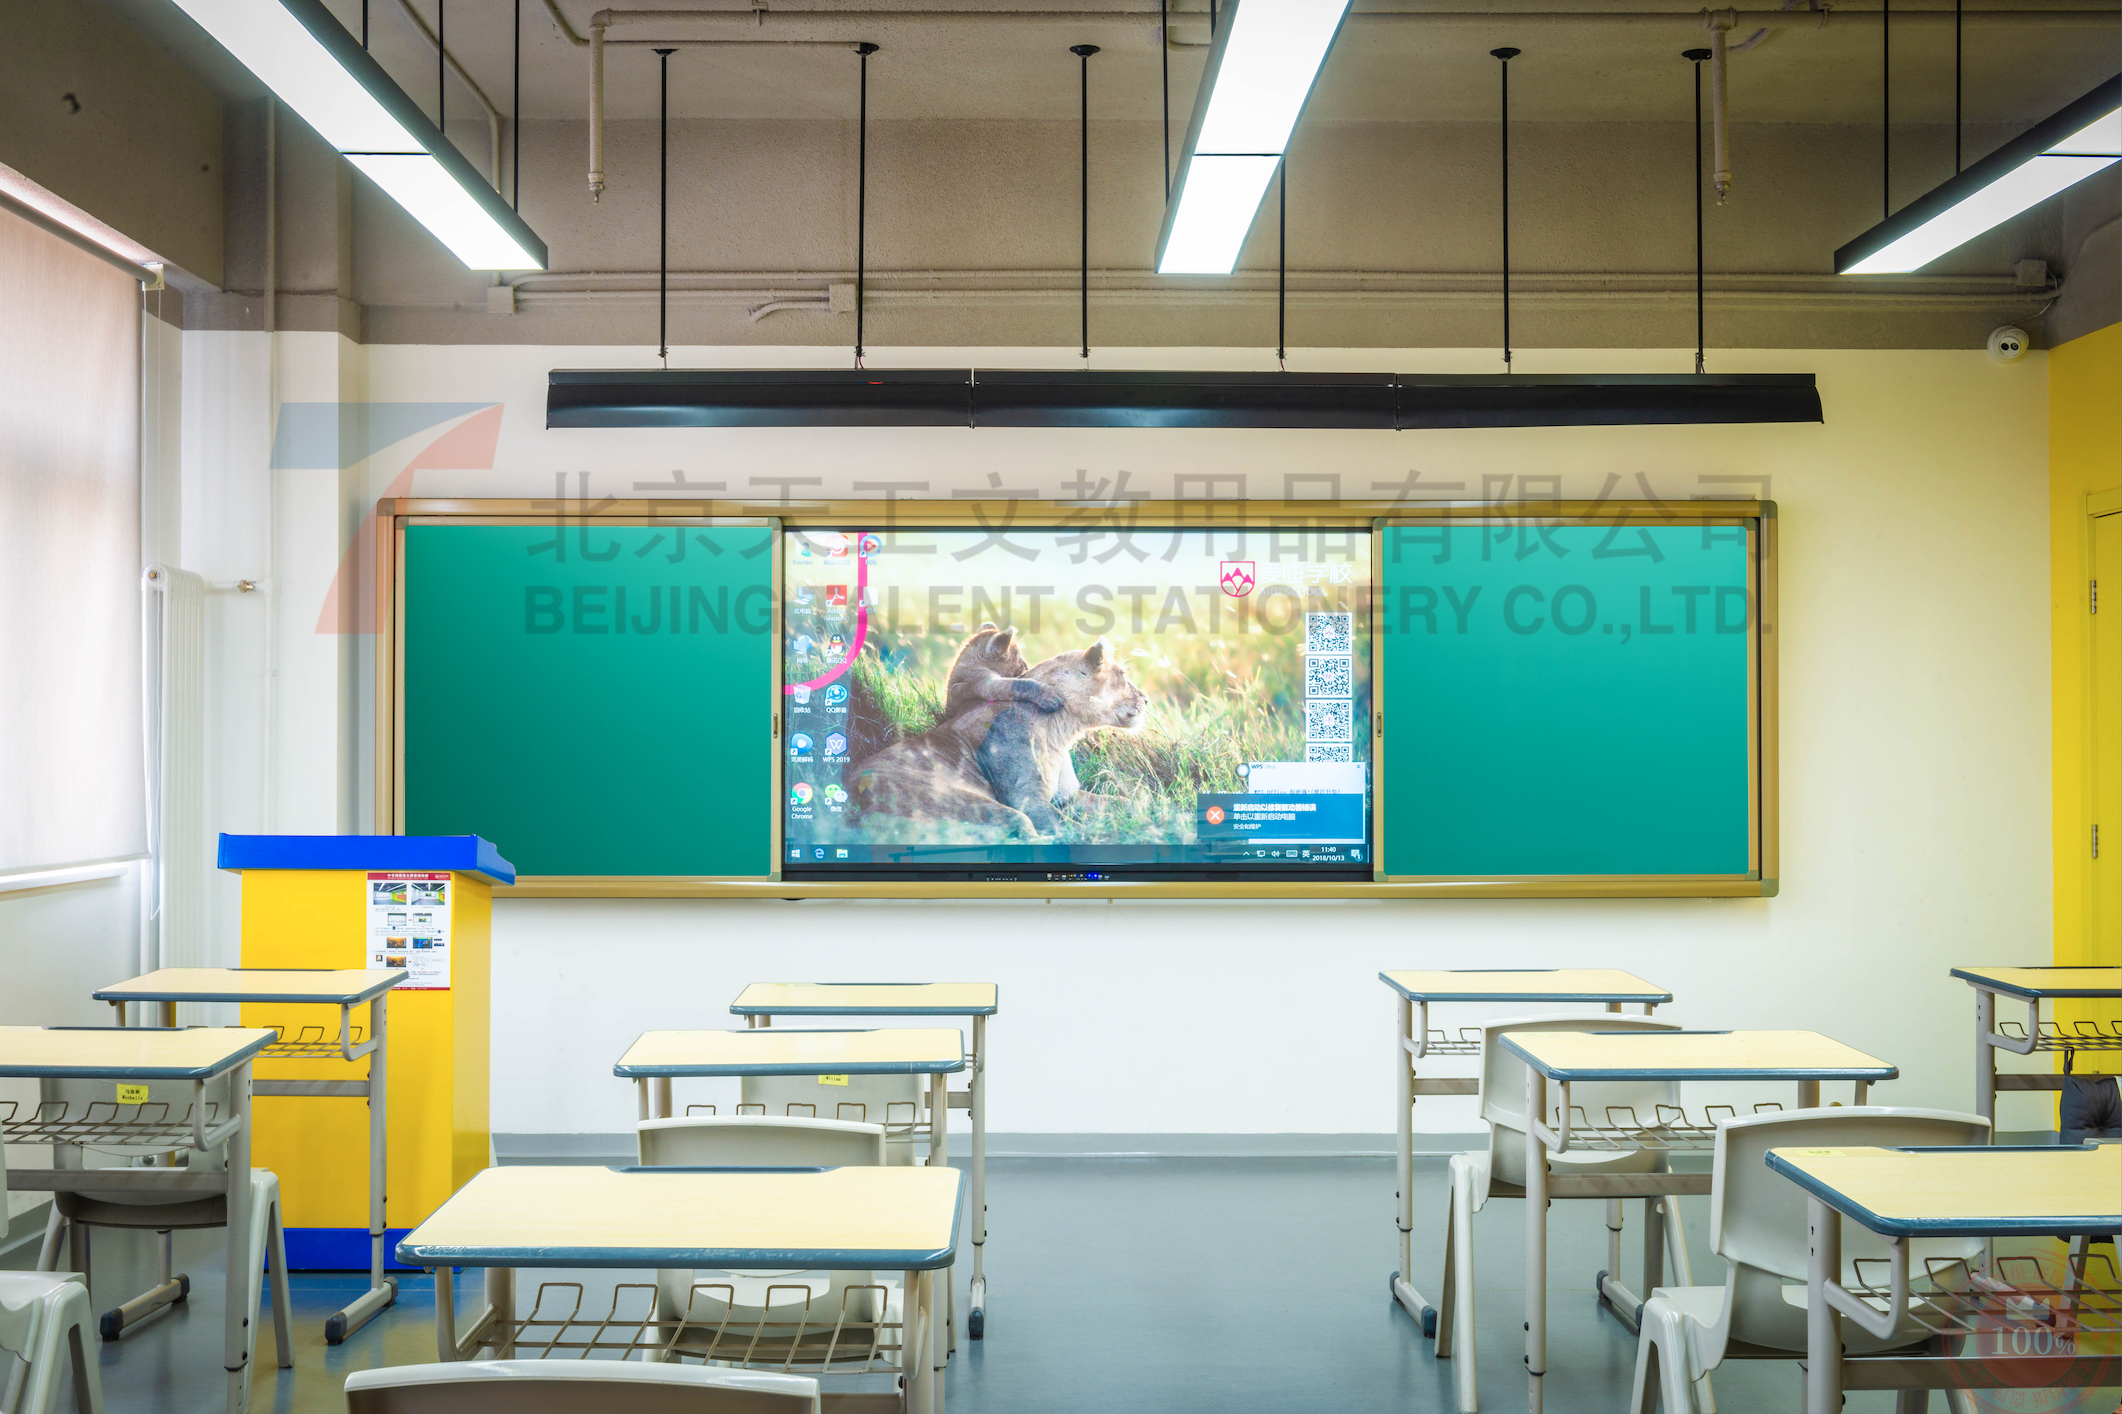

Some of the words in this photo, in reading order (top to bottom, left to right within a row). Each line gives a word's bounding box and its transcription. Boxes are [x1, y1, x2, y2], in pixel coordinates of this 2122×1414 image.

[1258, 562, 1353, 584] 爱迪学校
[1258, 587, 1282, 596] AIDI
[1284, 587, 1328, 596] SCHOOL
[1302, 850, 1311, 858] 英
